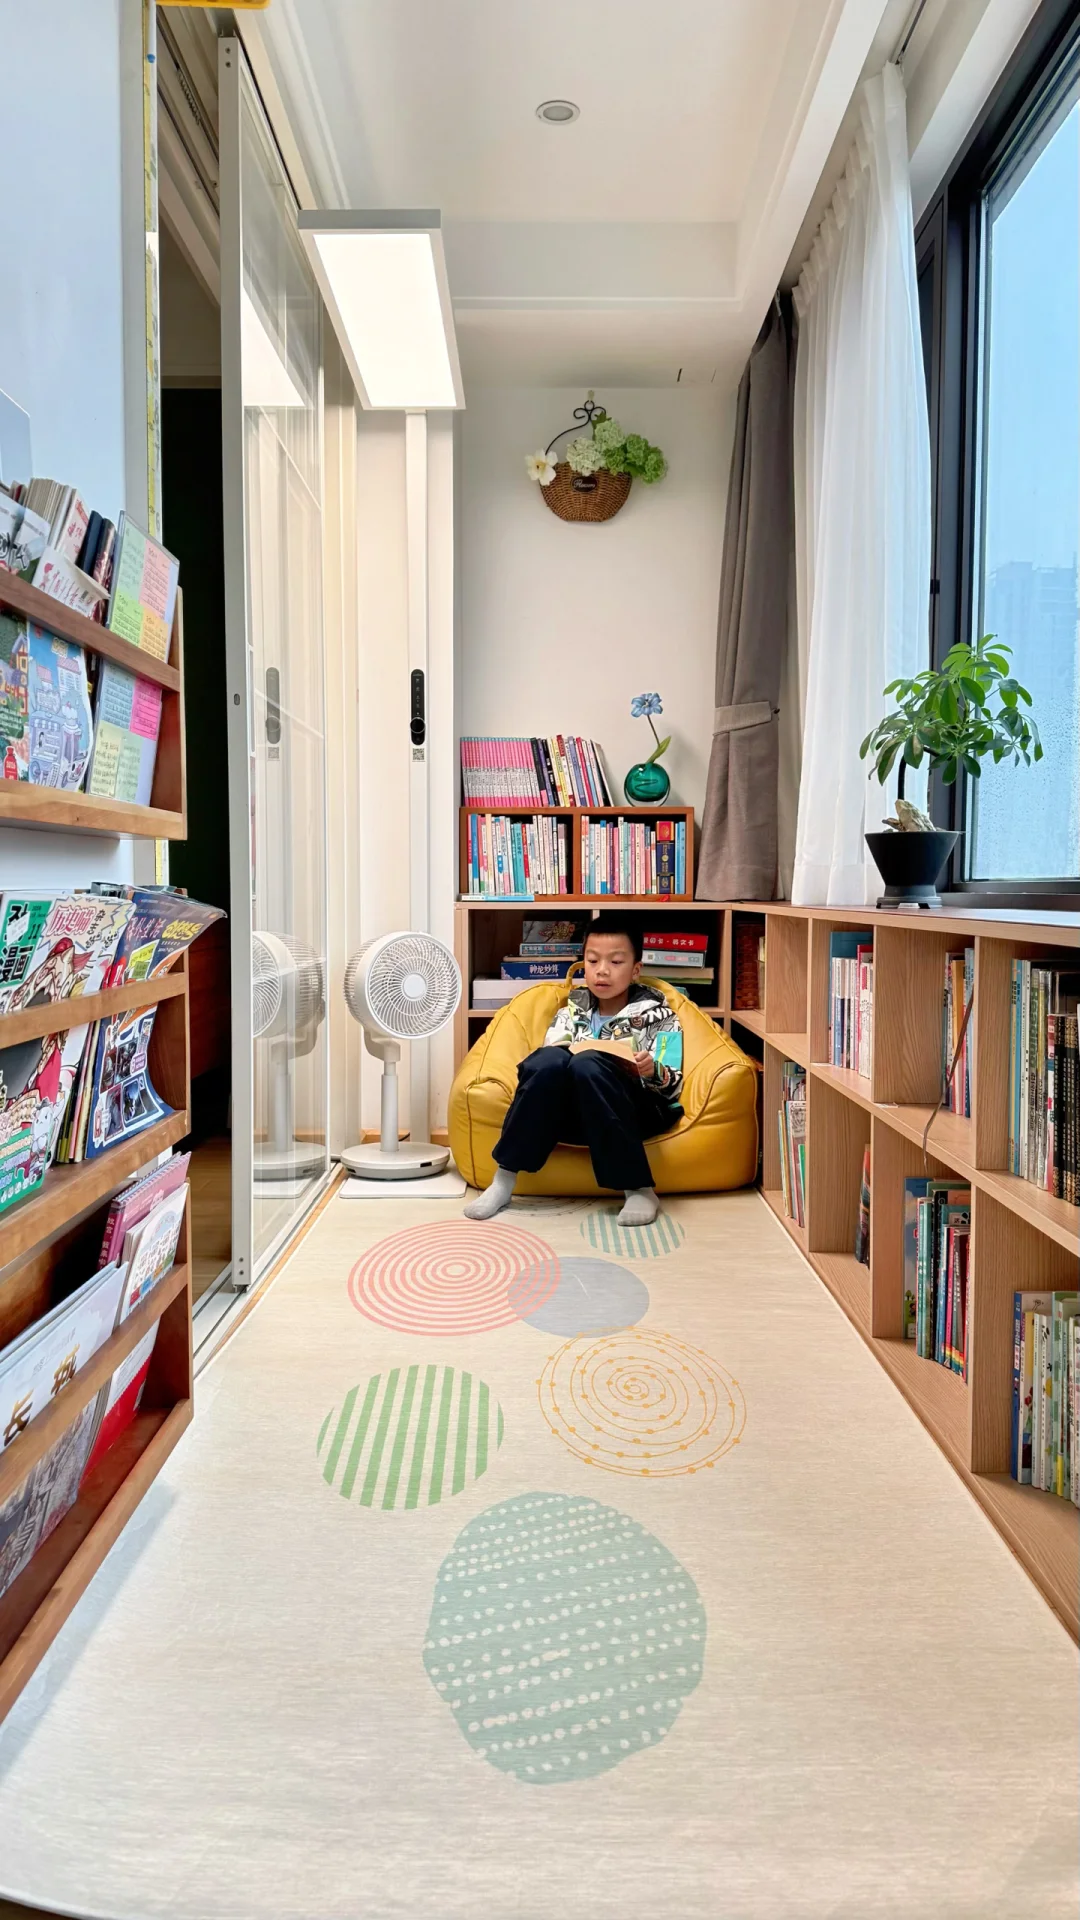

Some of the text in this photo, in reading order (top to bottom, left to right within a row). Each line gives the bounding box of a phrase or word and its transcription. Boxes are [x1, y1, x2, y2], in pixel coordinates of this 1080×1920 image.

[46, 905, 98, 937] 历史喵
[0, 945, 34, 984] 漫画
